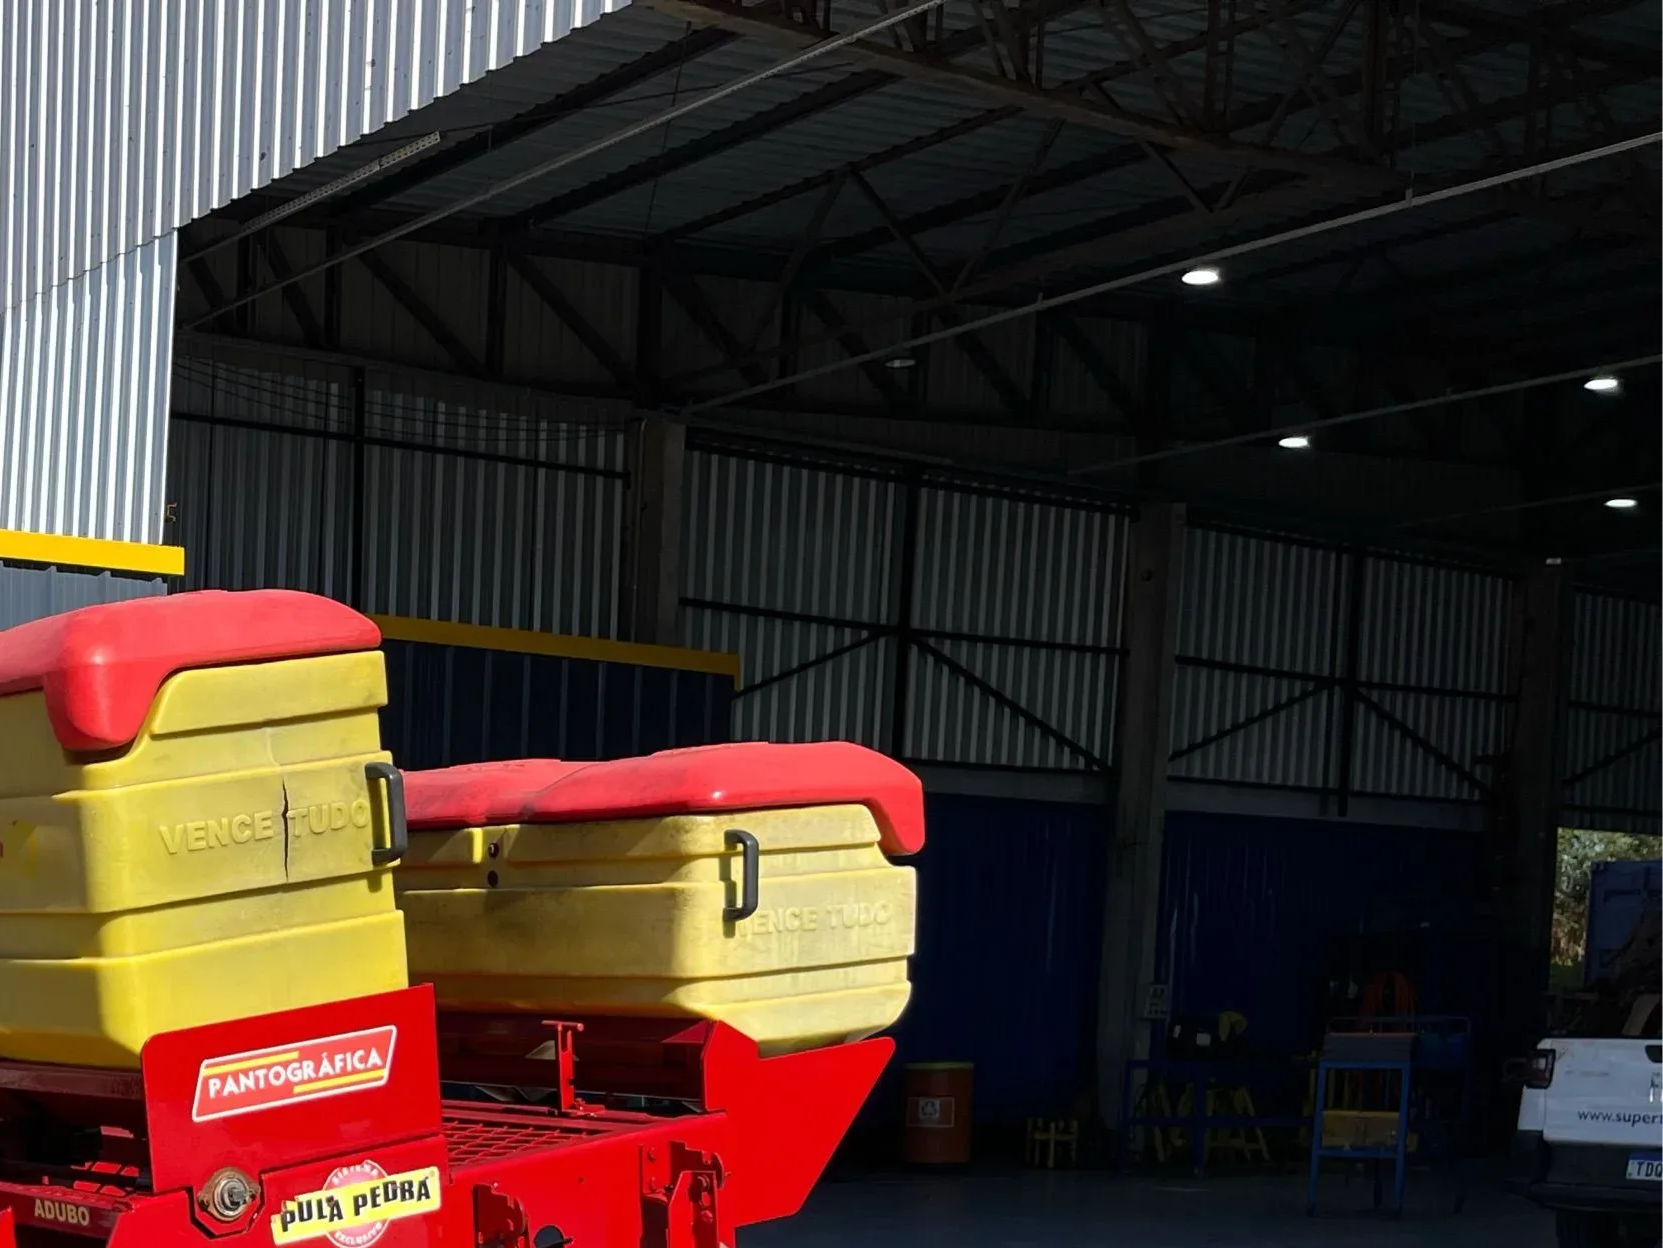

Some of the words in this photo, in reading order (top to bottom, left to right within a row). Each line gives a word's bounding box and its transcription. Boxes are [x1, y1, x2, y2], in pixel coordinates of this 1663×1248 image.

[159, 810, 274, 855] VENCE
[287, 799, 370, 838] TUDO
[827, 901, 892, 930] TUDO
[208, 1048, 383, 1099] PANTOGRÁFICA
[1578, 1109, 1662, 1128] www.super
[35, 1199, 89, 1226] ADUBO
[281, 1195, 343, 1232] PULA
